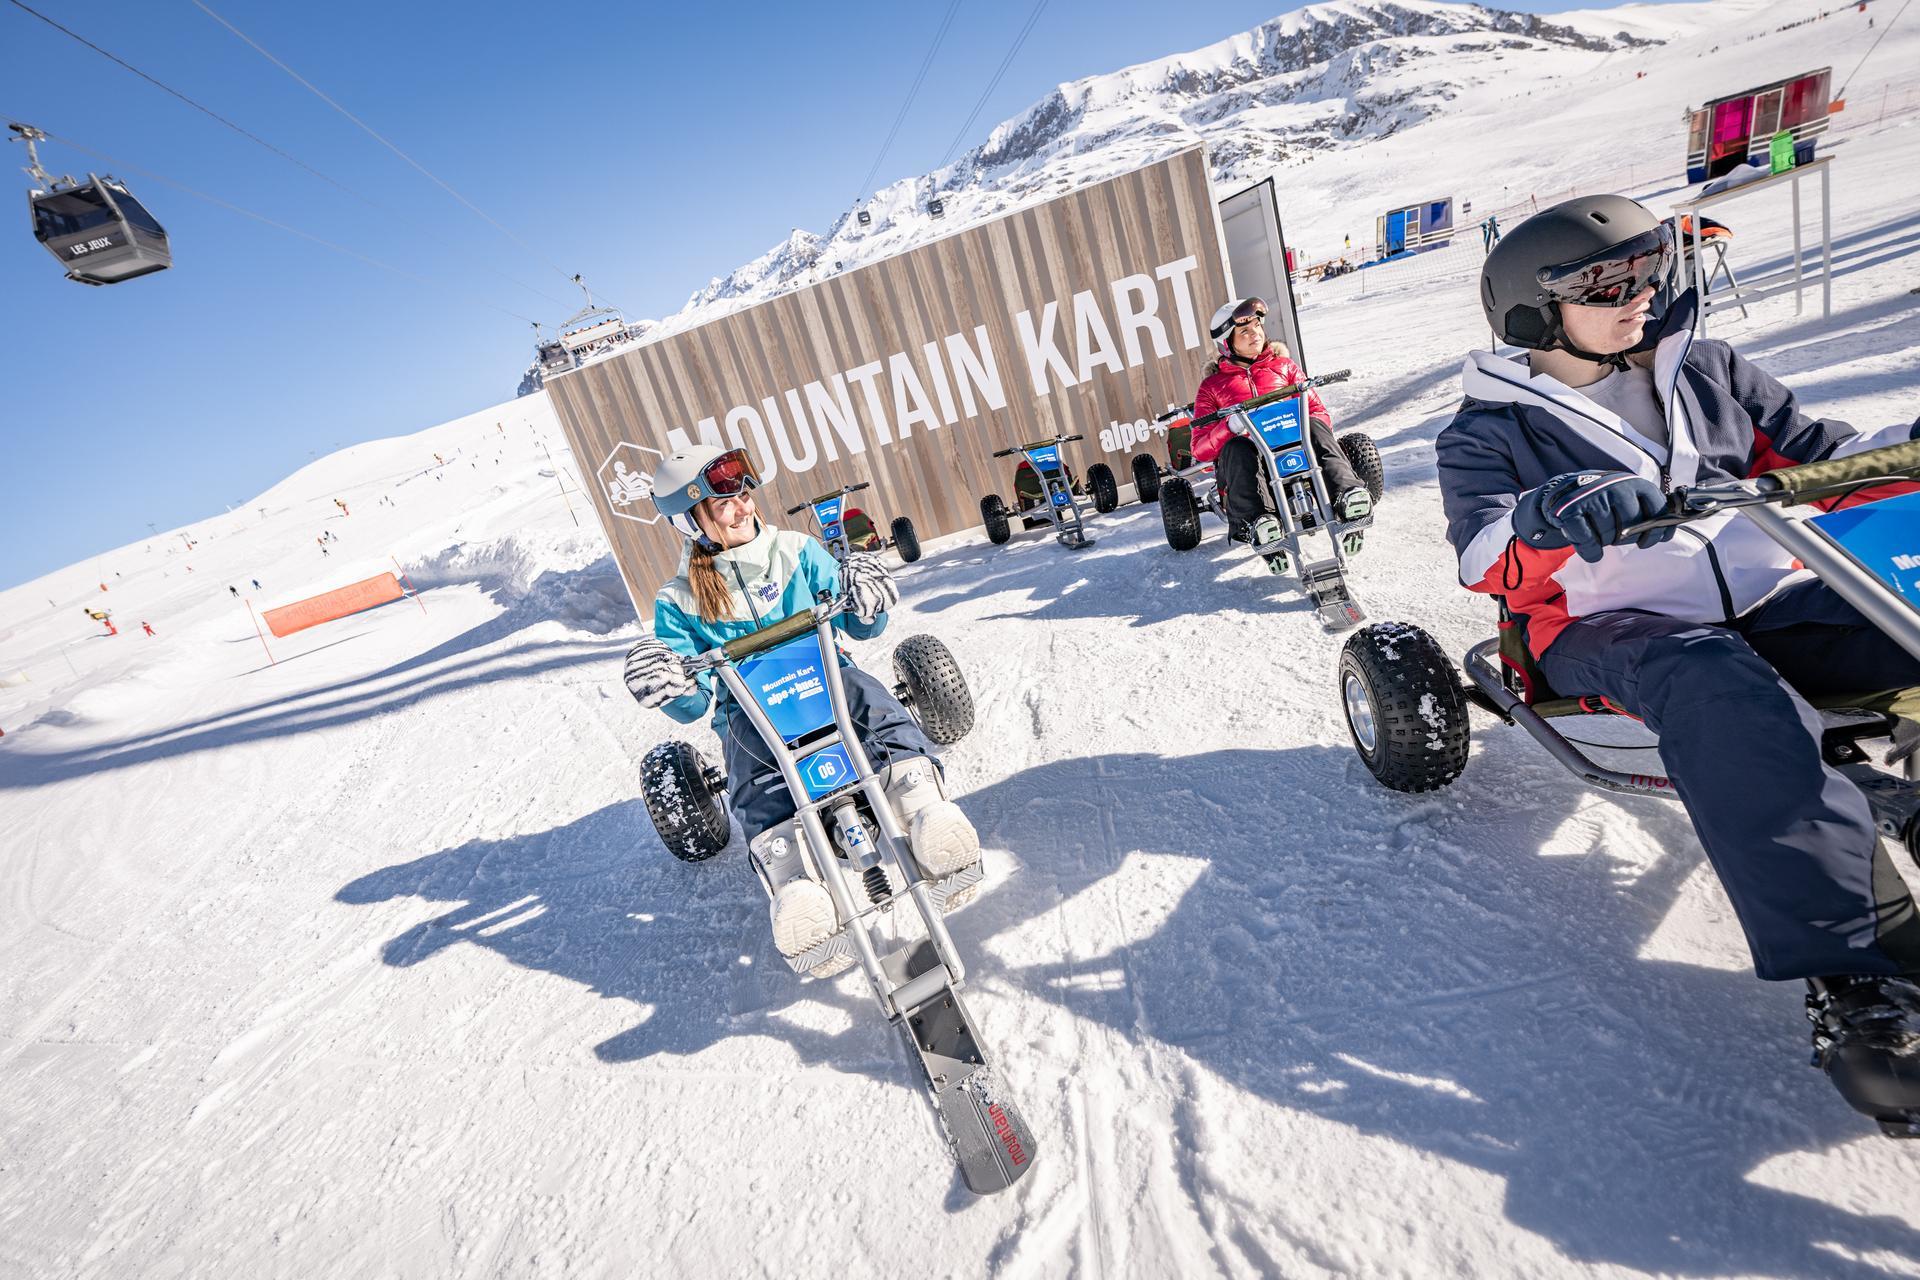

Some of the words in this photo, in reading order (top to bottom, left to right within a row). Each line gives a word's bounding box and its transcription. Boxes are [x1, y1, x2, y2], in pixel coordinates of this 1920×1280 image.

[70, 243, 88, 255] LES
[87, 236, 112, 251] JEUX
[1016, 254, 1200, 397] KART
[1099, 418, 1151, 453] alpe
[757, 583, 774, 597] alpe
[762, 672, 797, 693] Mountain
[796, 664, 816, 682] Kart
[766, 690, 789, 706] alpe
[794, 676, 822, 693] huez
[817, 761, 836, 780] 06
[988, 1103, 1027, 1166] mountain
